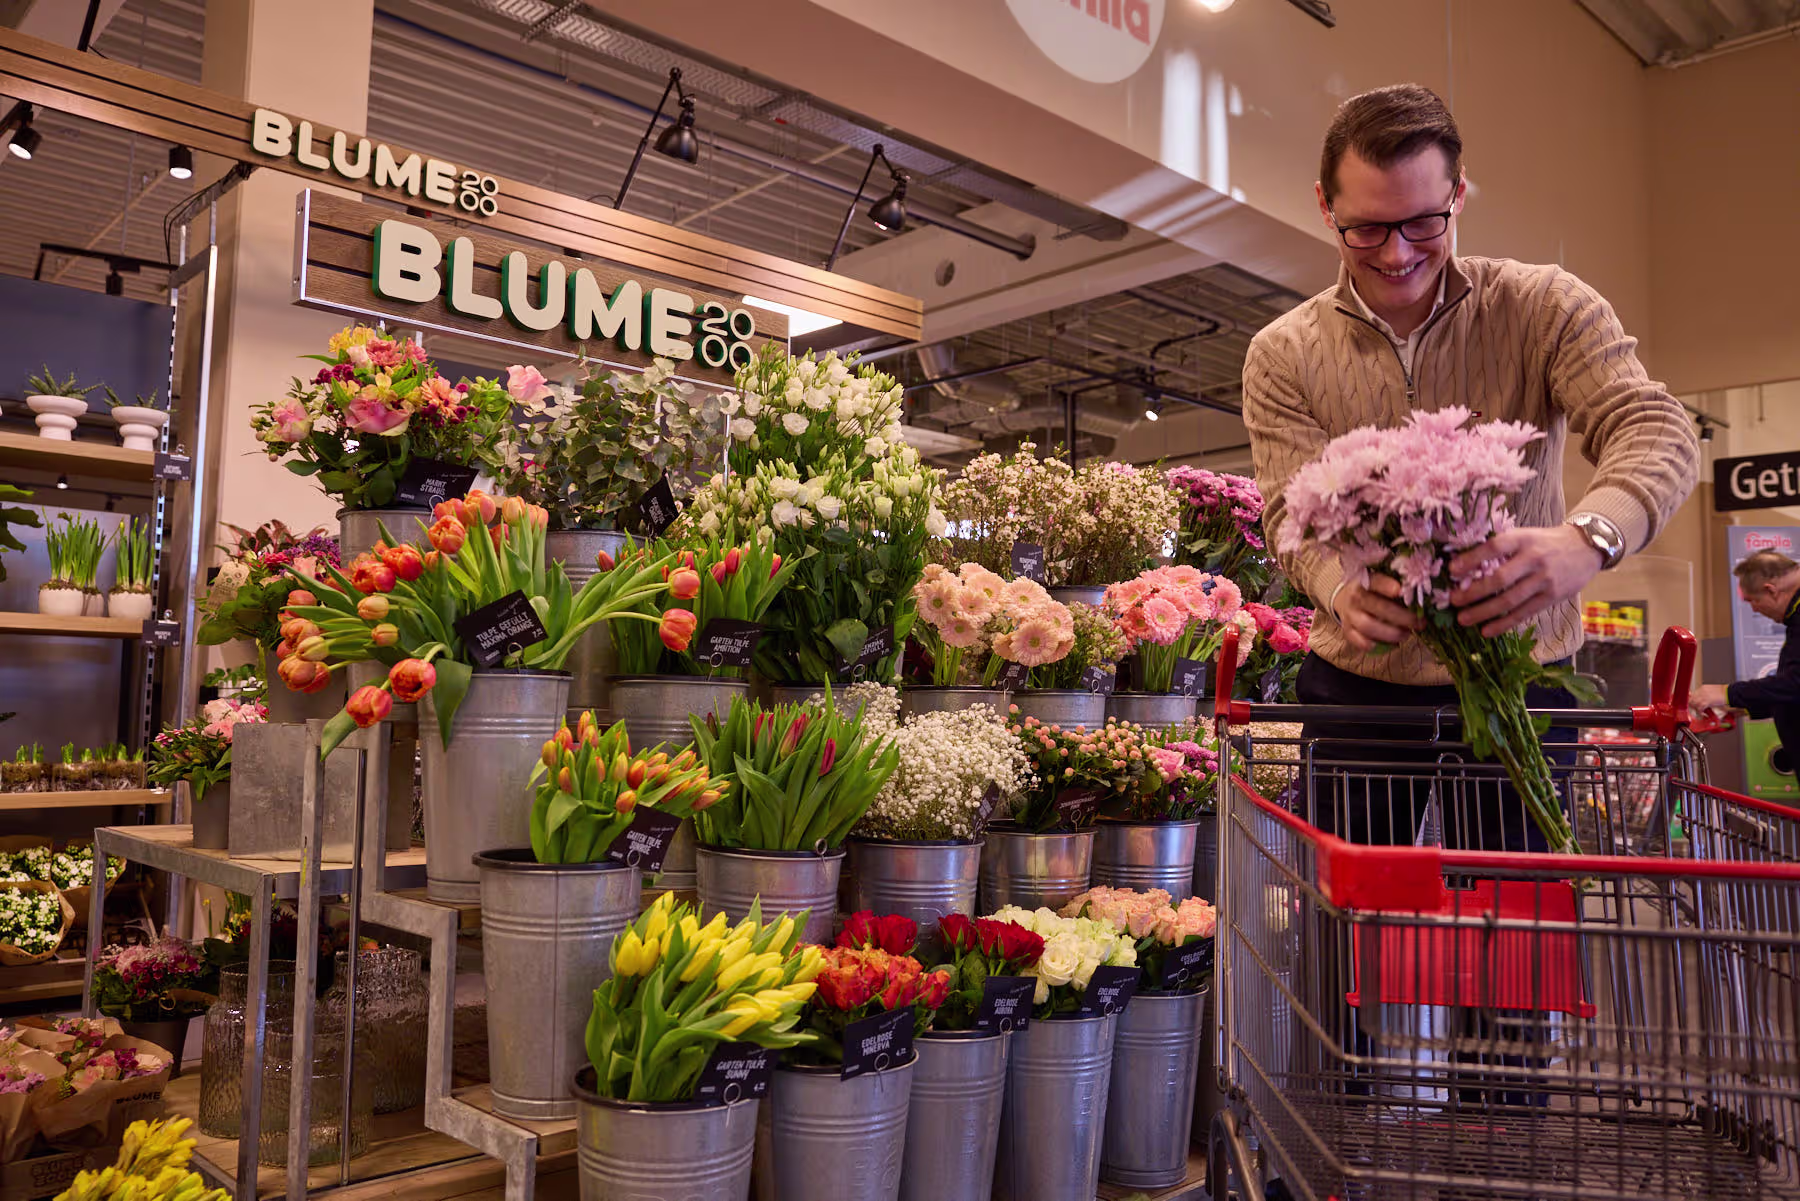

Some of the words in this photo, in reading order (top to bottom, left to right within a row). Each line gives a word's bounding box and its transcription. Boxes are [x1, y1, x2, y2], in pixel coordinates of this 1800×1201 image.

[252, 107, 457, 205] BLUME
[373, 218, 695, 362] BLUME
[425, 478, 447, 488] MARKT
[1730, 461, 1800, 500] Get
[1744, 531, 1792, 550] famila
[476, 626, 499, 642] TULPE
[480, 631, 508, 650] MAXIMA
[507, 618, 535, 636] ORANGE
[710, 636, 734, 646] GARTEN
[734, 638, 750, 648] TULPE
[713, 644, 742, 654] AMBITION
[626, 830, 648, 844] GARTEN
[646, 836, 663, 849] TULPE
[1097, 987, 1121, 996] EDELROSE
[994, 998, 1019, 1007] EDELROSE
[994, 1006, 1014, 1015] AURORA
[861, 1030, 893, 1049] EDELROSE
[862, 1039, 890, 1057] MINERVA
[716, 1060, 746, 1071] GARTEN
[745, 1059, 767, 1070] TULPE
[724, 1069, 751, 1081] SUNNY
